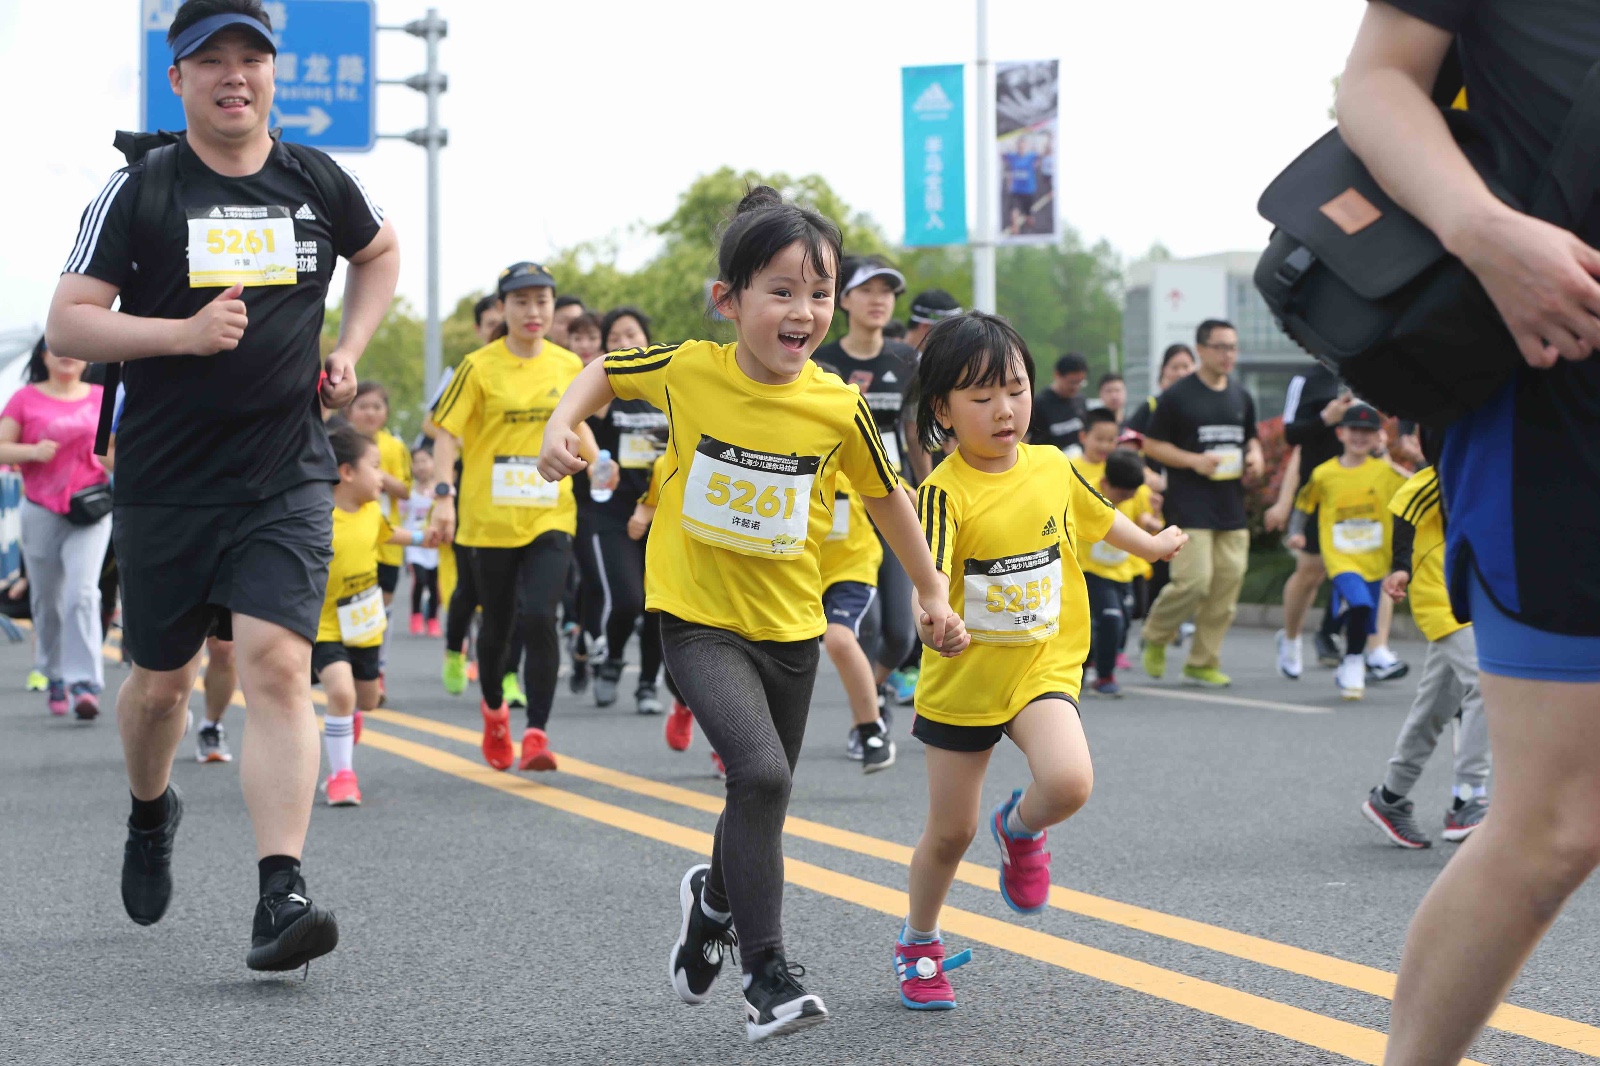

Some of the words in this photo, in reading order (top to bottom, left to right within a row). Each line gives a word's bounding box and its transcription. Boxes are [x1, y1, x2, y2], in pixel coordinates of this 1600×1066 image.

[206, 228, 275, 254] 5261
[705, 472, 798, 520] 5261
[985, 576, 1052, 613] 5259
